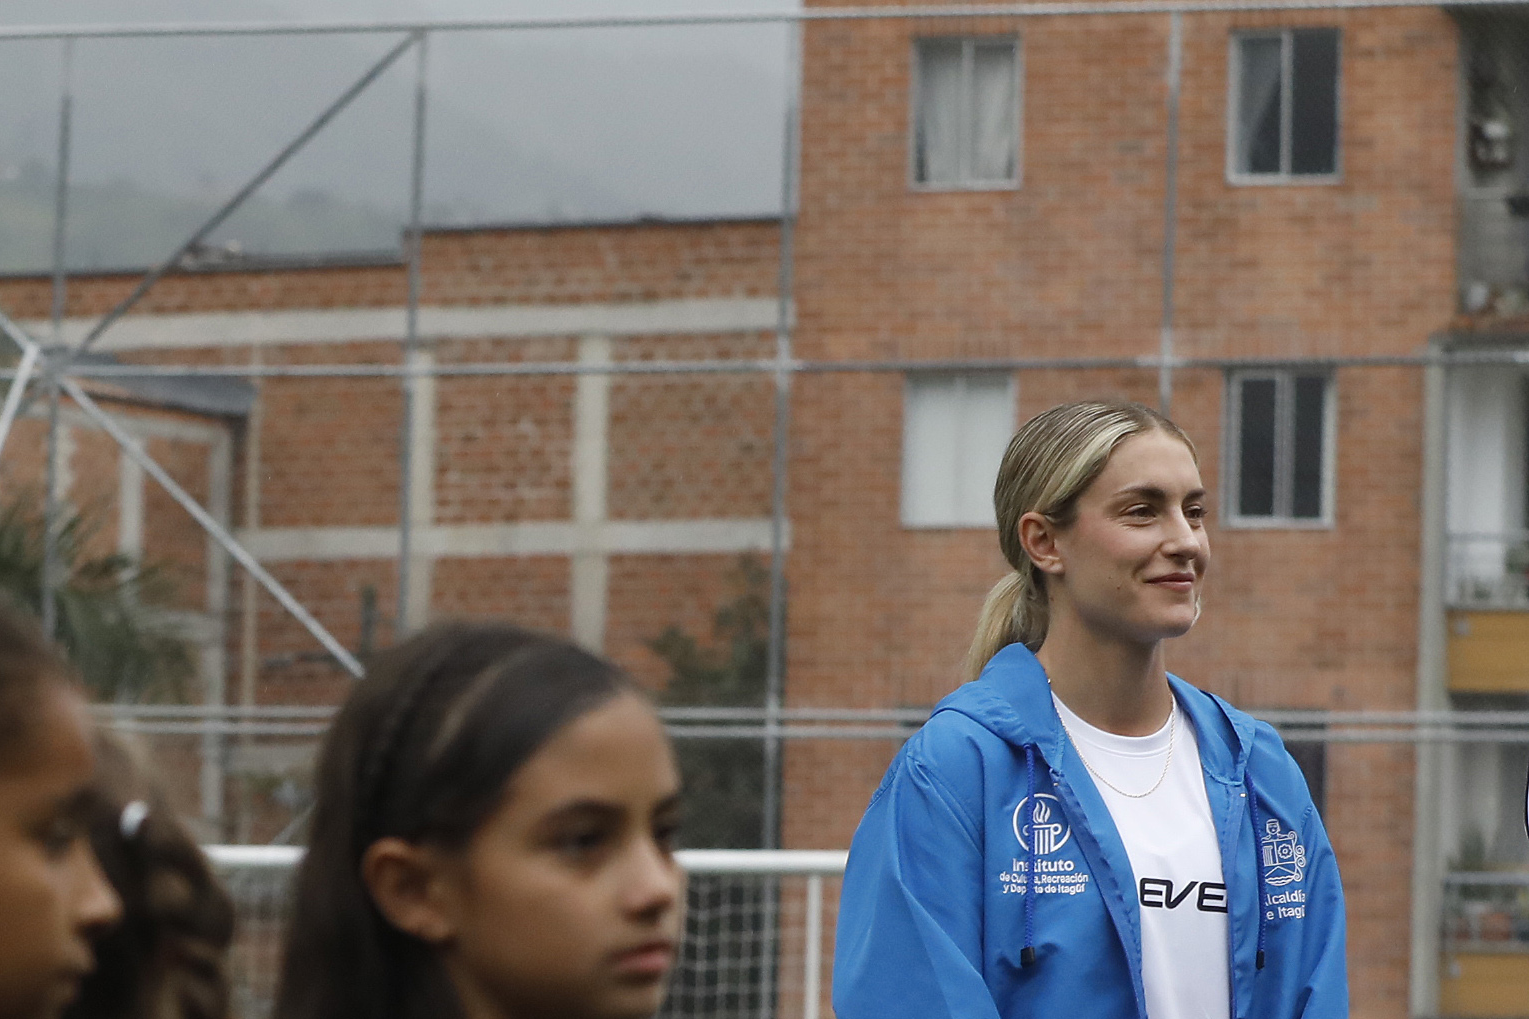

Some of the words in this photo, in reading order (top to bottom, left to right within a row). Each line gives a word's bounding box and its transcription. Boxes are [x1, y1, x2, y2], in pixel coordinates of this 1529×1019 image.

[999, 871, 1011, 882] de
[1041, 872, 1089, 884] Recreación
[1002, 884, 1010, 894] y
[1010, 884, 1044, 896] Depte
[1044, 884, 1057, 894] de
